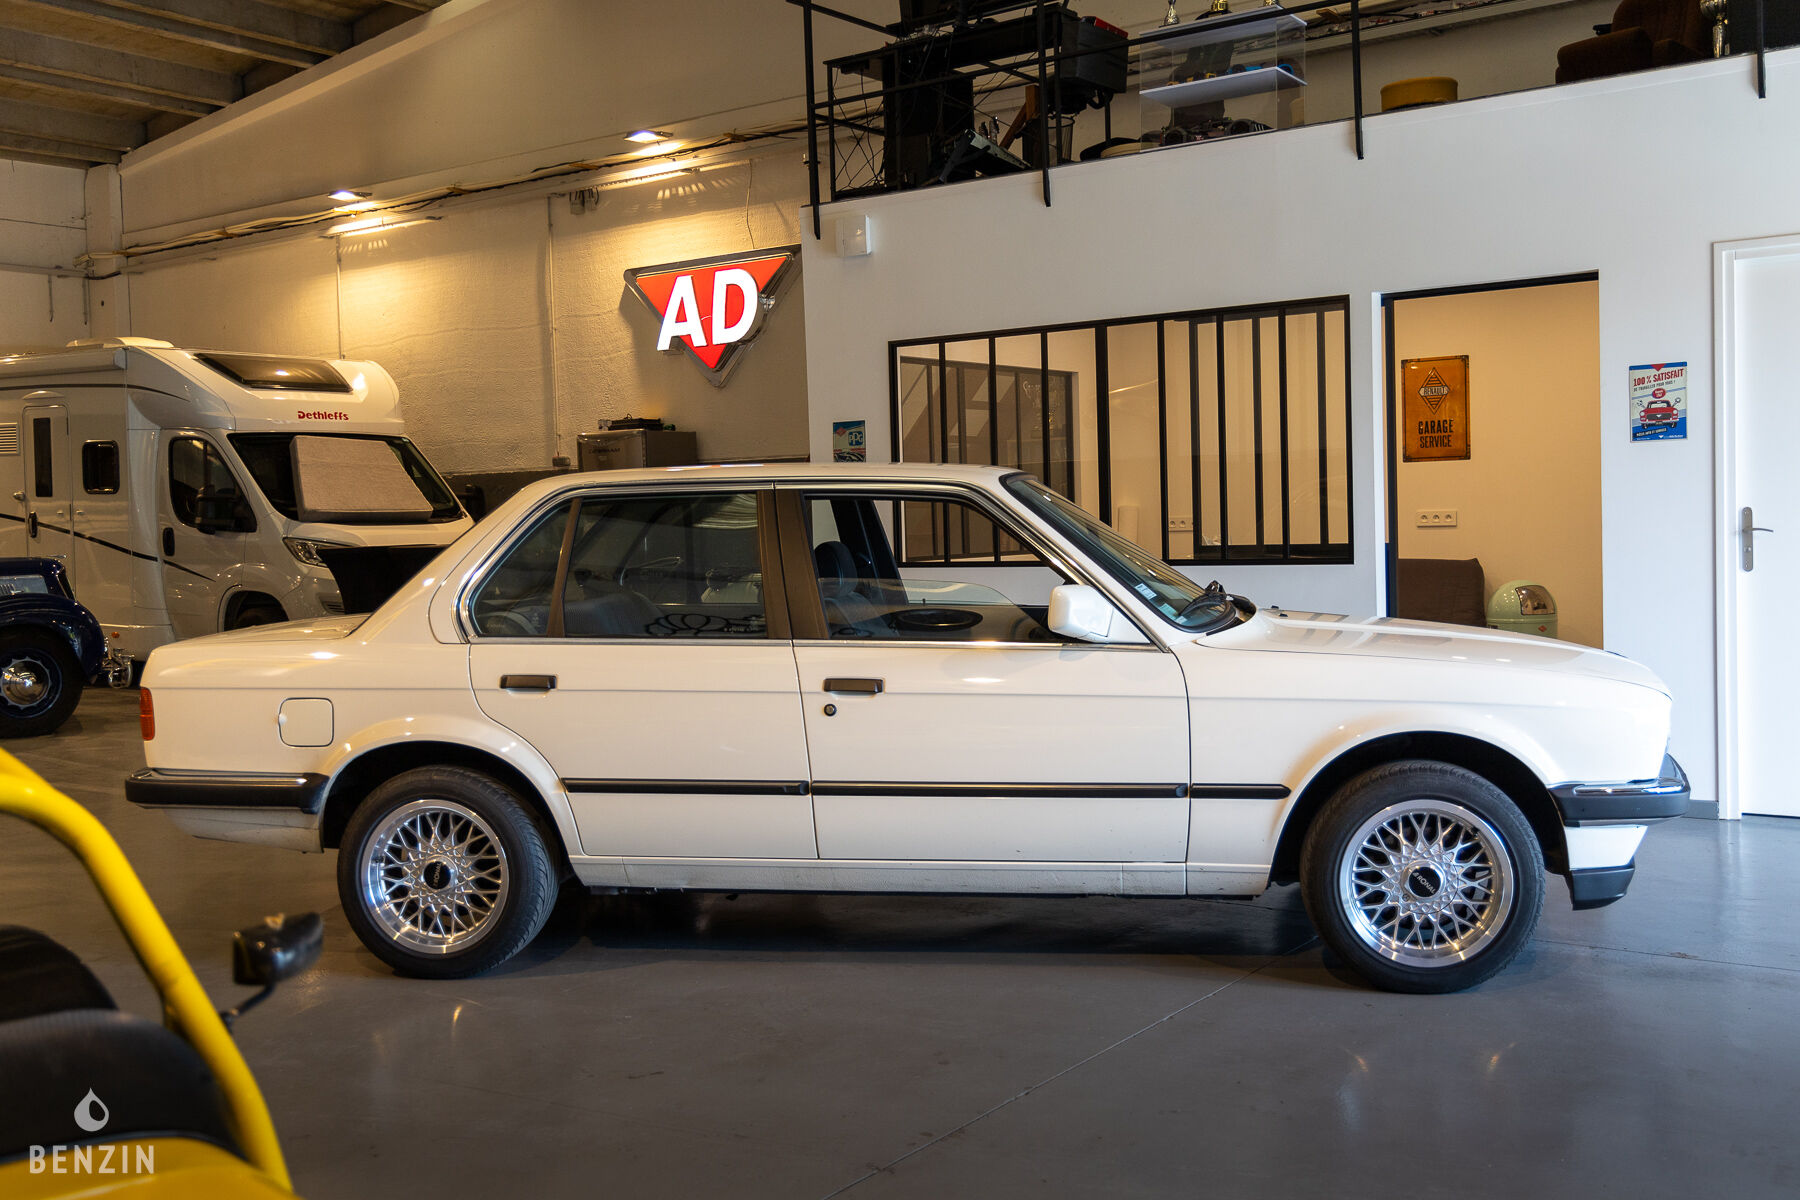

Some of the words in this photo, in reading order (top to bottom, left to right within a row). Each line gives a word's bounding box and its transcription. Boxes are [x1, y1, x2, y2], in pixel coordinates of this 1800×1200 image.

[657, 268, 758, 350] AD
[1633, 377, 1645, 387] 100
[1653, 368, 1684, 382] SATISFAIT
[1423, 386, 1445, 396] RENAULT
[297, 411, 349, 420] Dethleffs
[1418, 419, 1454, 435] GARAGE
[1420, 435, 1452, 448] SERVICE
[1416, 875, 1436, 894] RONAL
